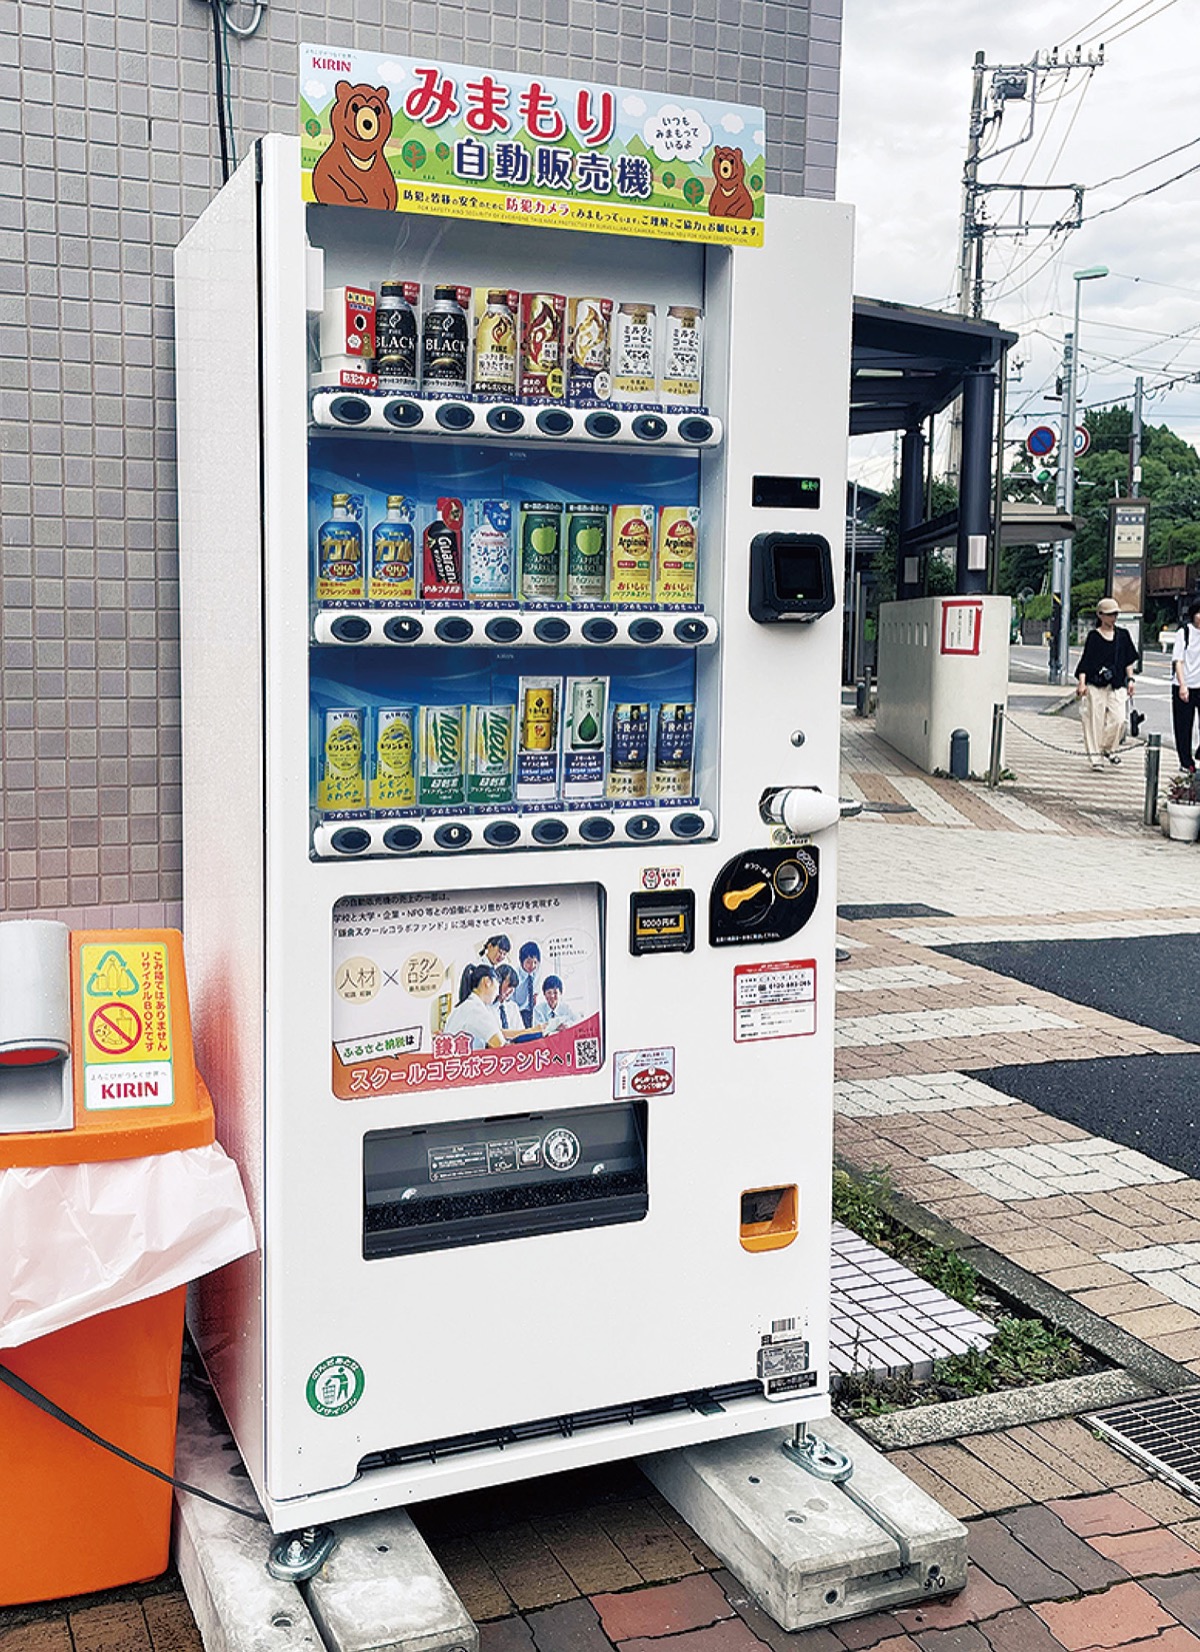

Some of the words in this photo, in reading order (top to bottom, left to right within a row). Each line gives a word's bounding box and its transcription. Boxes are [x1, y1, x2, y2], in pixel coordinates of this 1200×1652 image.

[312, 57, 351, 72] KIRIN
[405, 68, 615, 145] みまもり
[662, 116, 690, 126] いつも
[656, 127, 699, 138] みまもって
[665, 140, 692, 150] いるよ
[455, 138, 651, 196] 自動販売機
[425, 338, 466, 352] BLACK
[663, 878, 678, 887] OK
[338, 967, 376, 990] 人材
[408, 958, 438, 972] テクノ
[408, 971, 440, 984] ロジー
[343, 1035, 415, 1059] ふるさと納税は
[434, 1032, 473, 1059] 鎌倉
[101, 1081, 159, 1099] KIRIN
